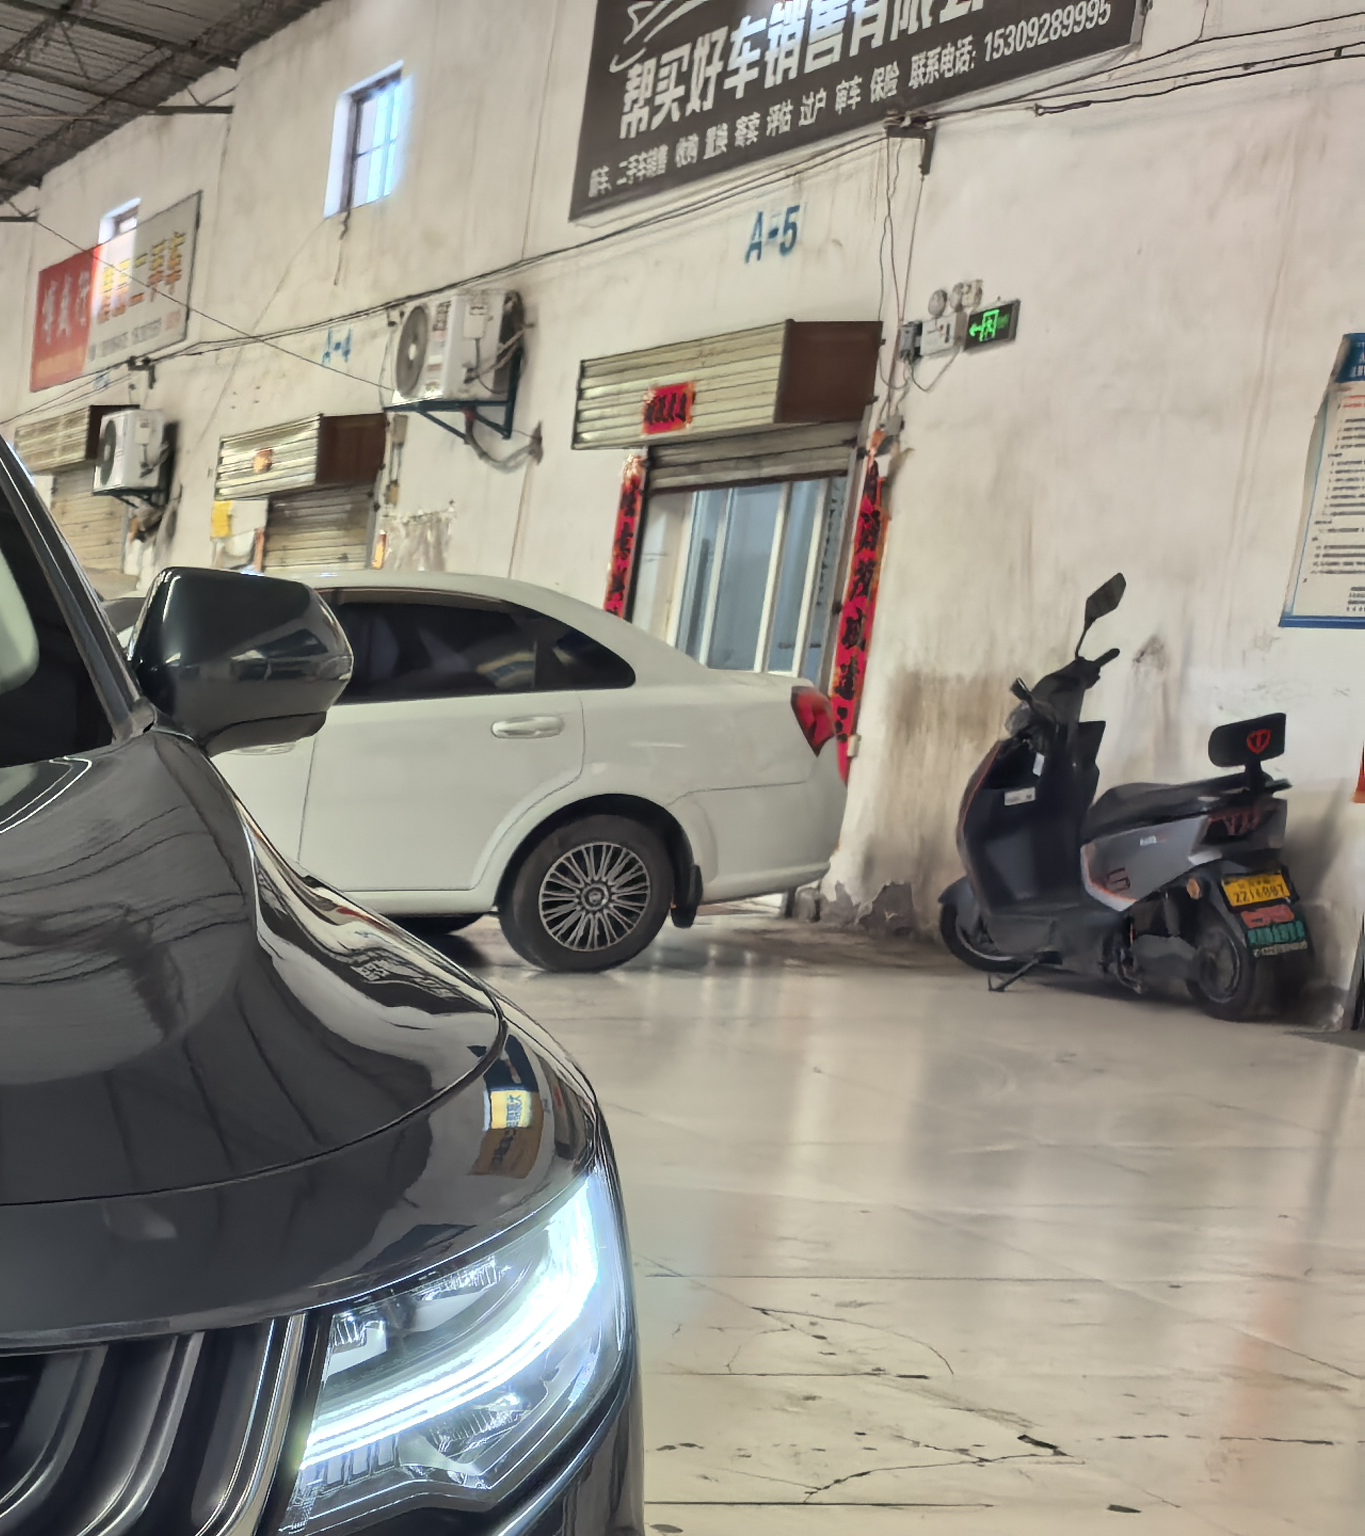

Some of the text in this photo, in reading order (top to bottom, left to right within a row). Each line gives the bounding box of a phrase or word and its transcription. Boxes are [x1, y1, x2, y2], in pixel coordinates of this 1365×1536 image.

[619, 0, 984, 140] 帮买好车销售有限
[870, 61, 900, 103] 保险
[983, 0, 1112, 63] 15309289995
[744, 204, 801, 264] A-5
